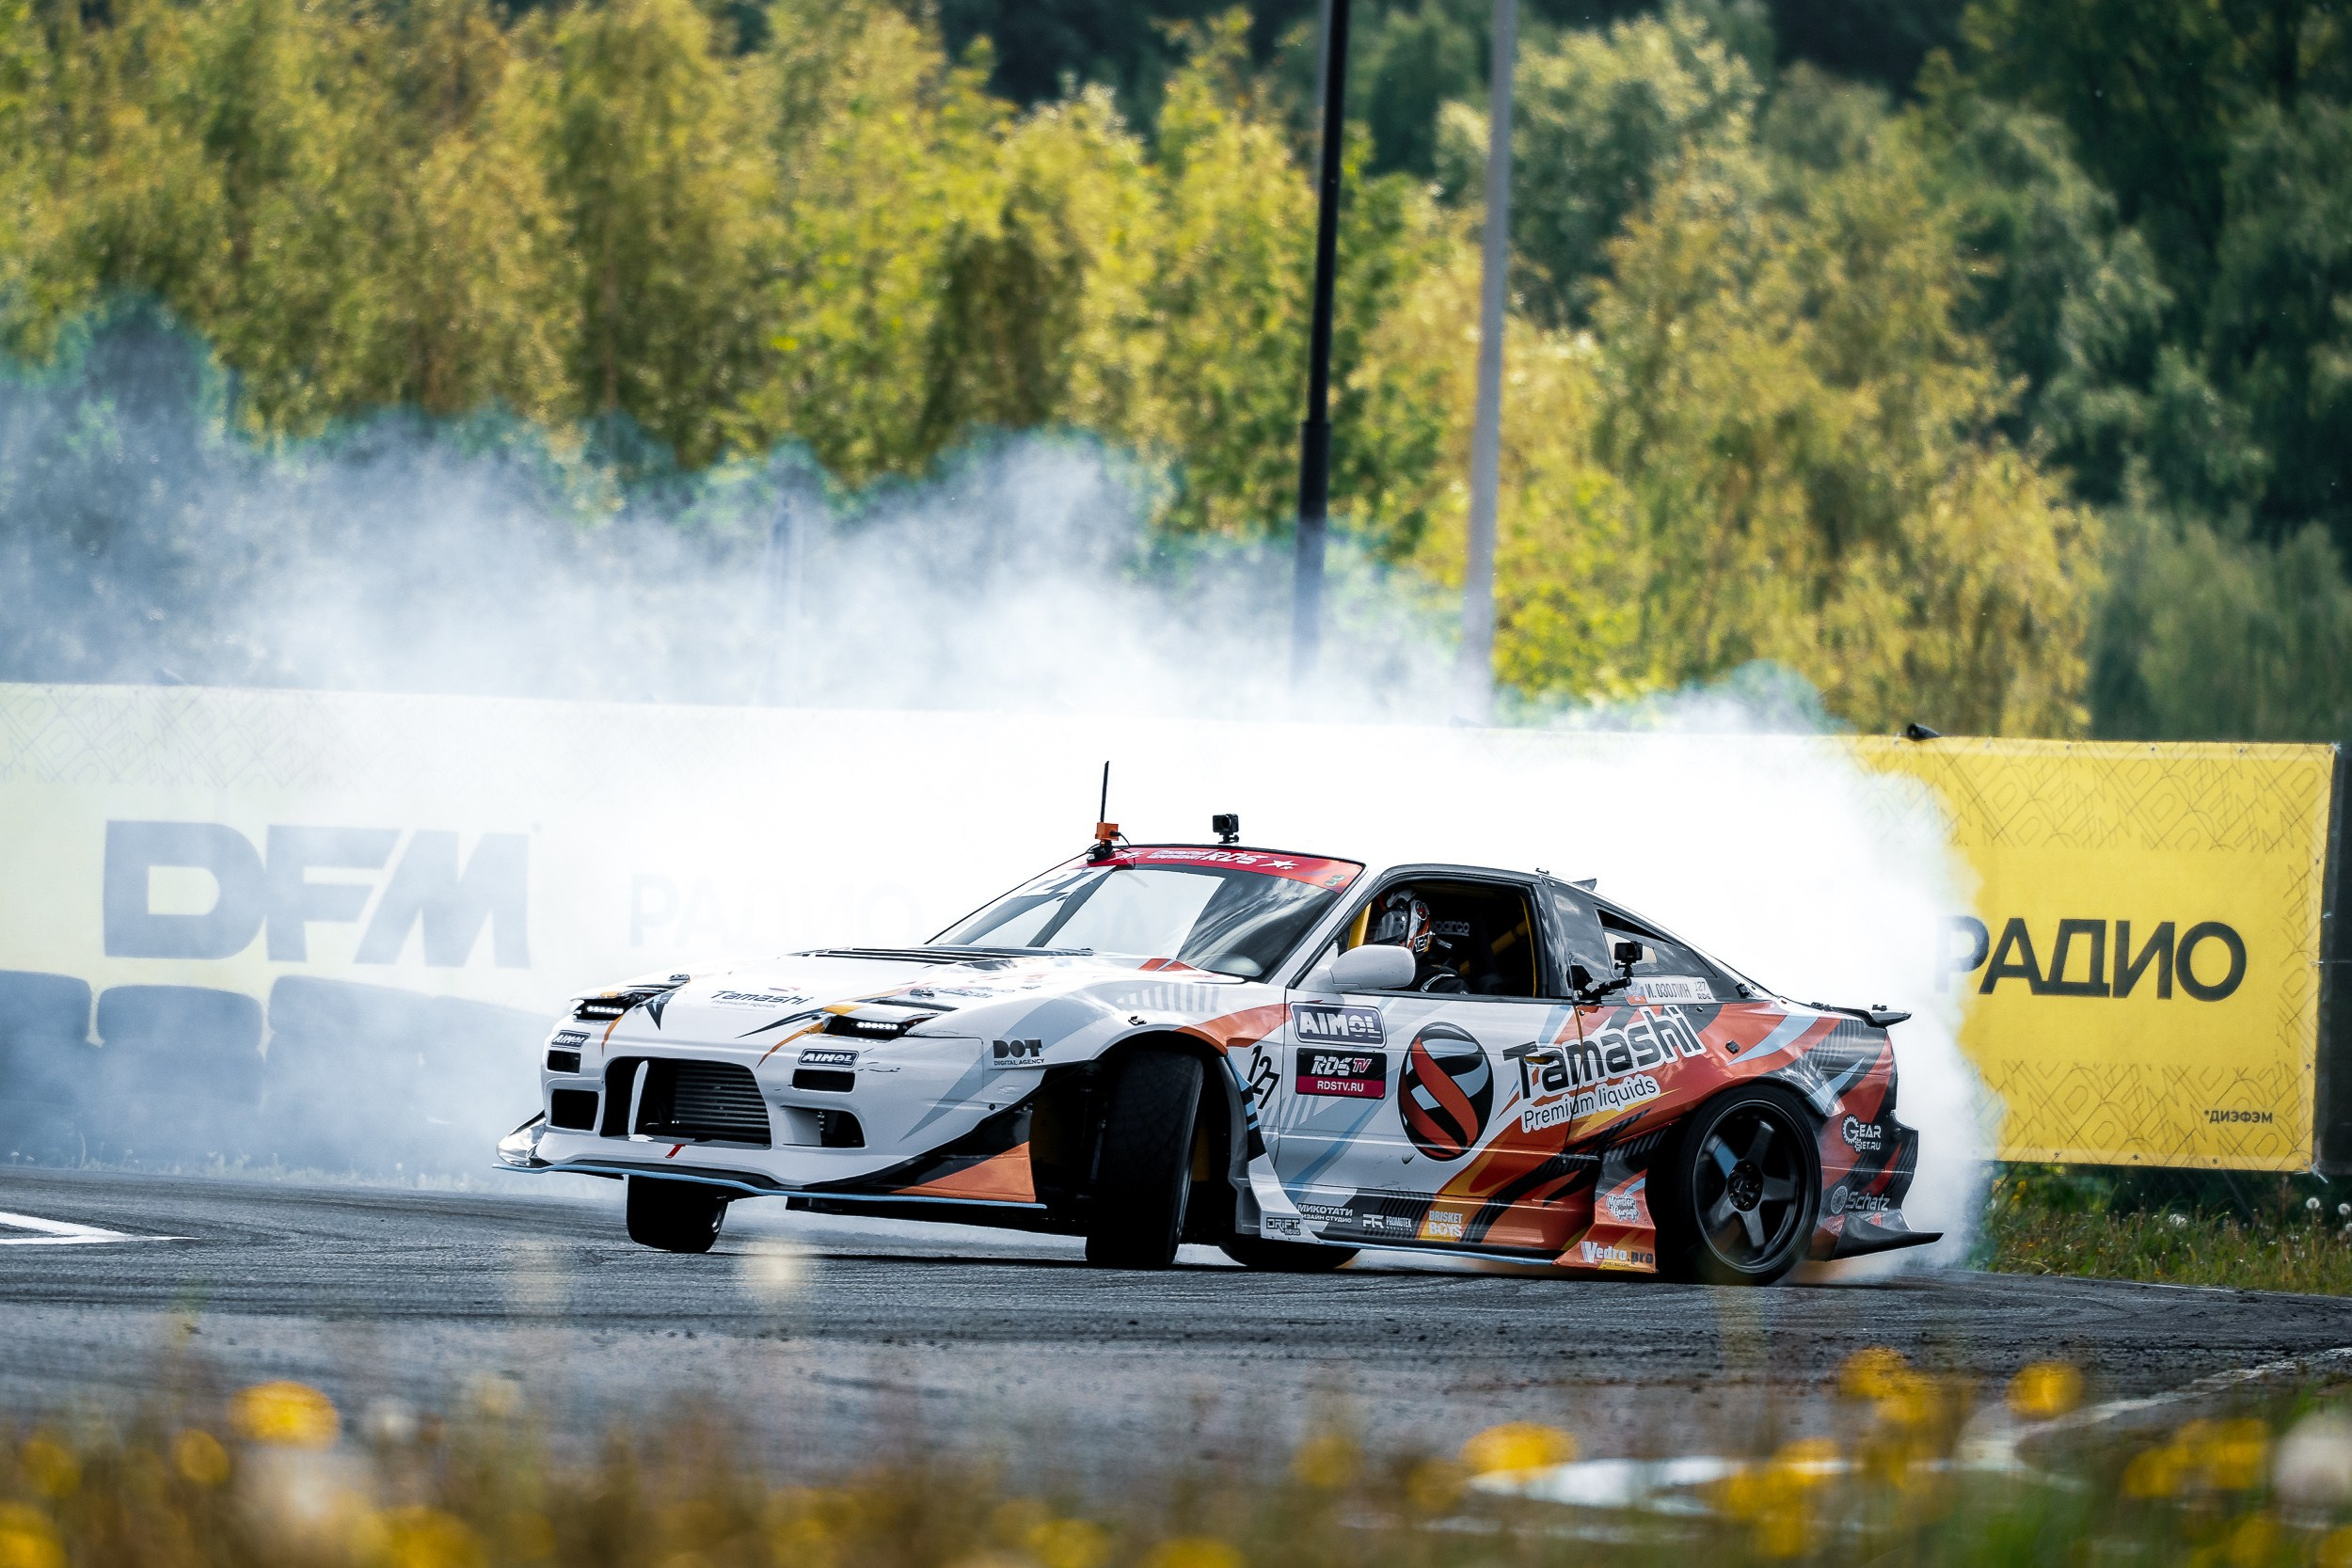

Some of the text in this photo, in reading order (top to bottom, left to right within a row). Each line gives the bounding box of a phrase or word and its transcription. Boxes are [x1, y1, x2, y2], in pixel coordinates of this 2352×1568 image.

[103, 819, 532, 970] DFM
[1934, 915, 2248, 1003] РАДИО
[710, 990, 815, 1006] Tamashi
[1645, 983, 1692, 999] И. ОЗОЛИН
[1299, 1011, 1381, 1039] AIMOL
[802, 1053, 853, 1064] AIMOL
[993, 1038, 1043, 1059] DOT
[1502, 1006, 1702, 1100] Tamashi
[1247, 1045, 1280, 1110] 127
[1317, 1080, 1364, 1092] RDSTV.RU
[1523, 1077, 1657, 1129] Premium liquids
[1298, 1204, 1354, 1216] МИКОТАТИ
[1845, 1191, 1890, 1212] Schatz
[1325, 1215, 1353, 1224] СТУДИО
[1429, 1210, 1463, 1223] BRISKET
[1428, 1222, 1463, 1239] BOYS
[1581, 1241, 1654, 1265] Vedro.pro
